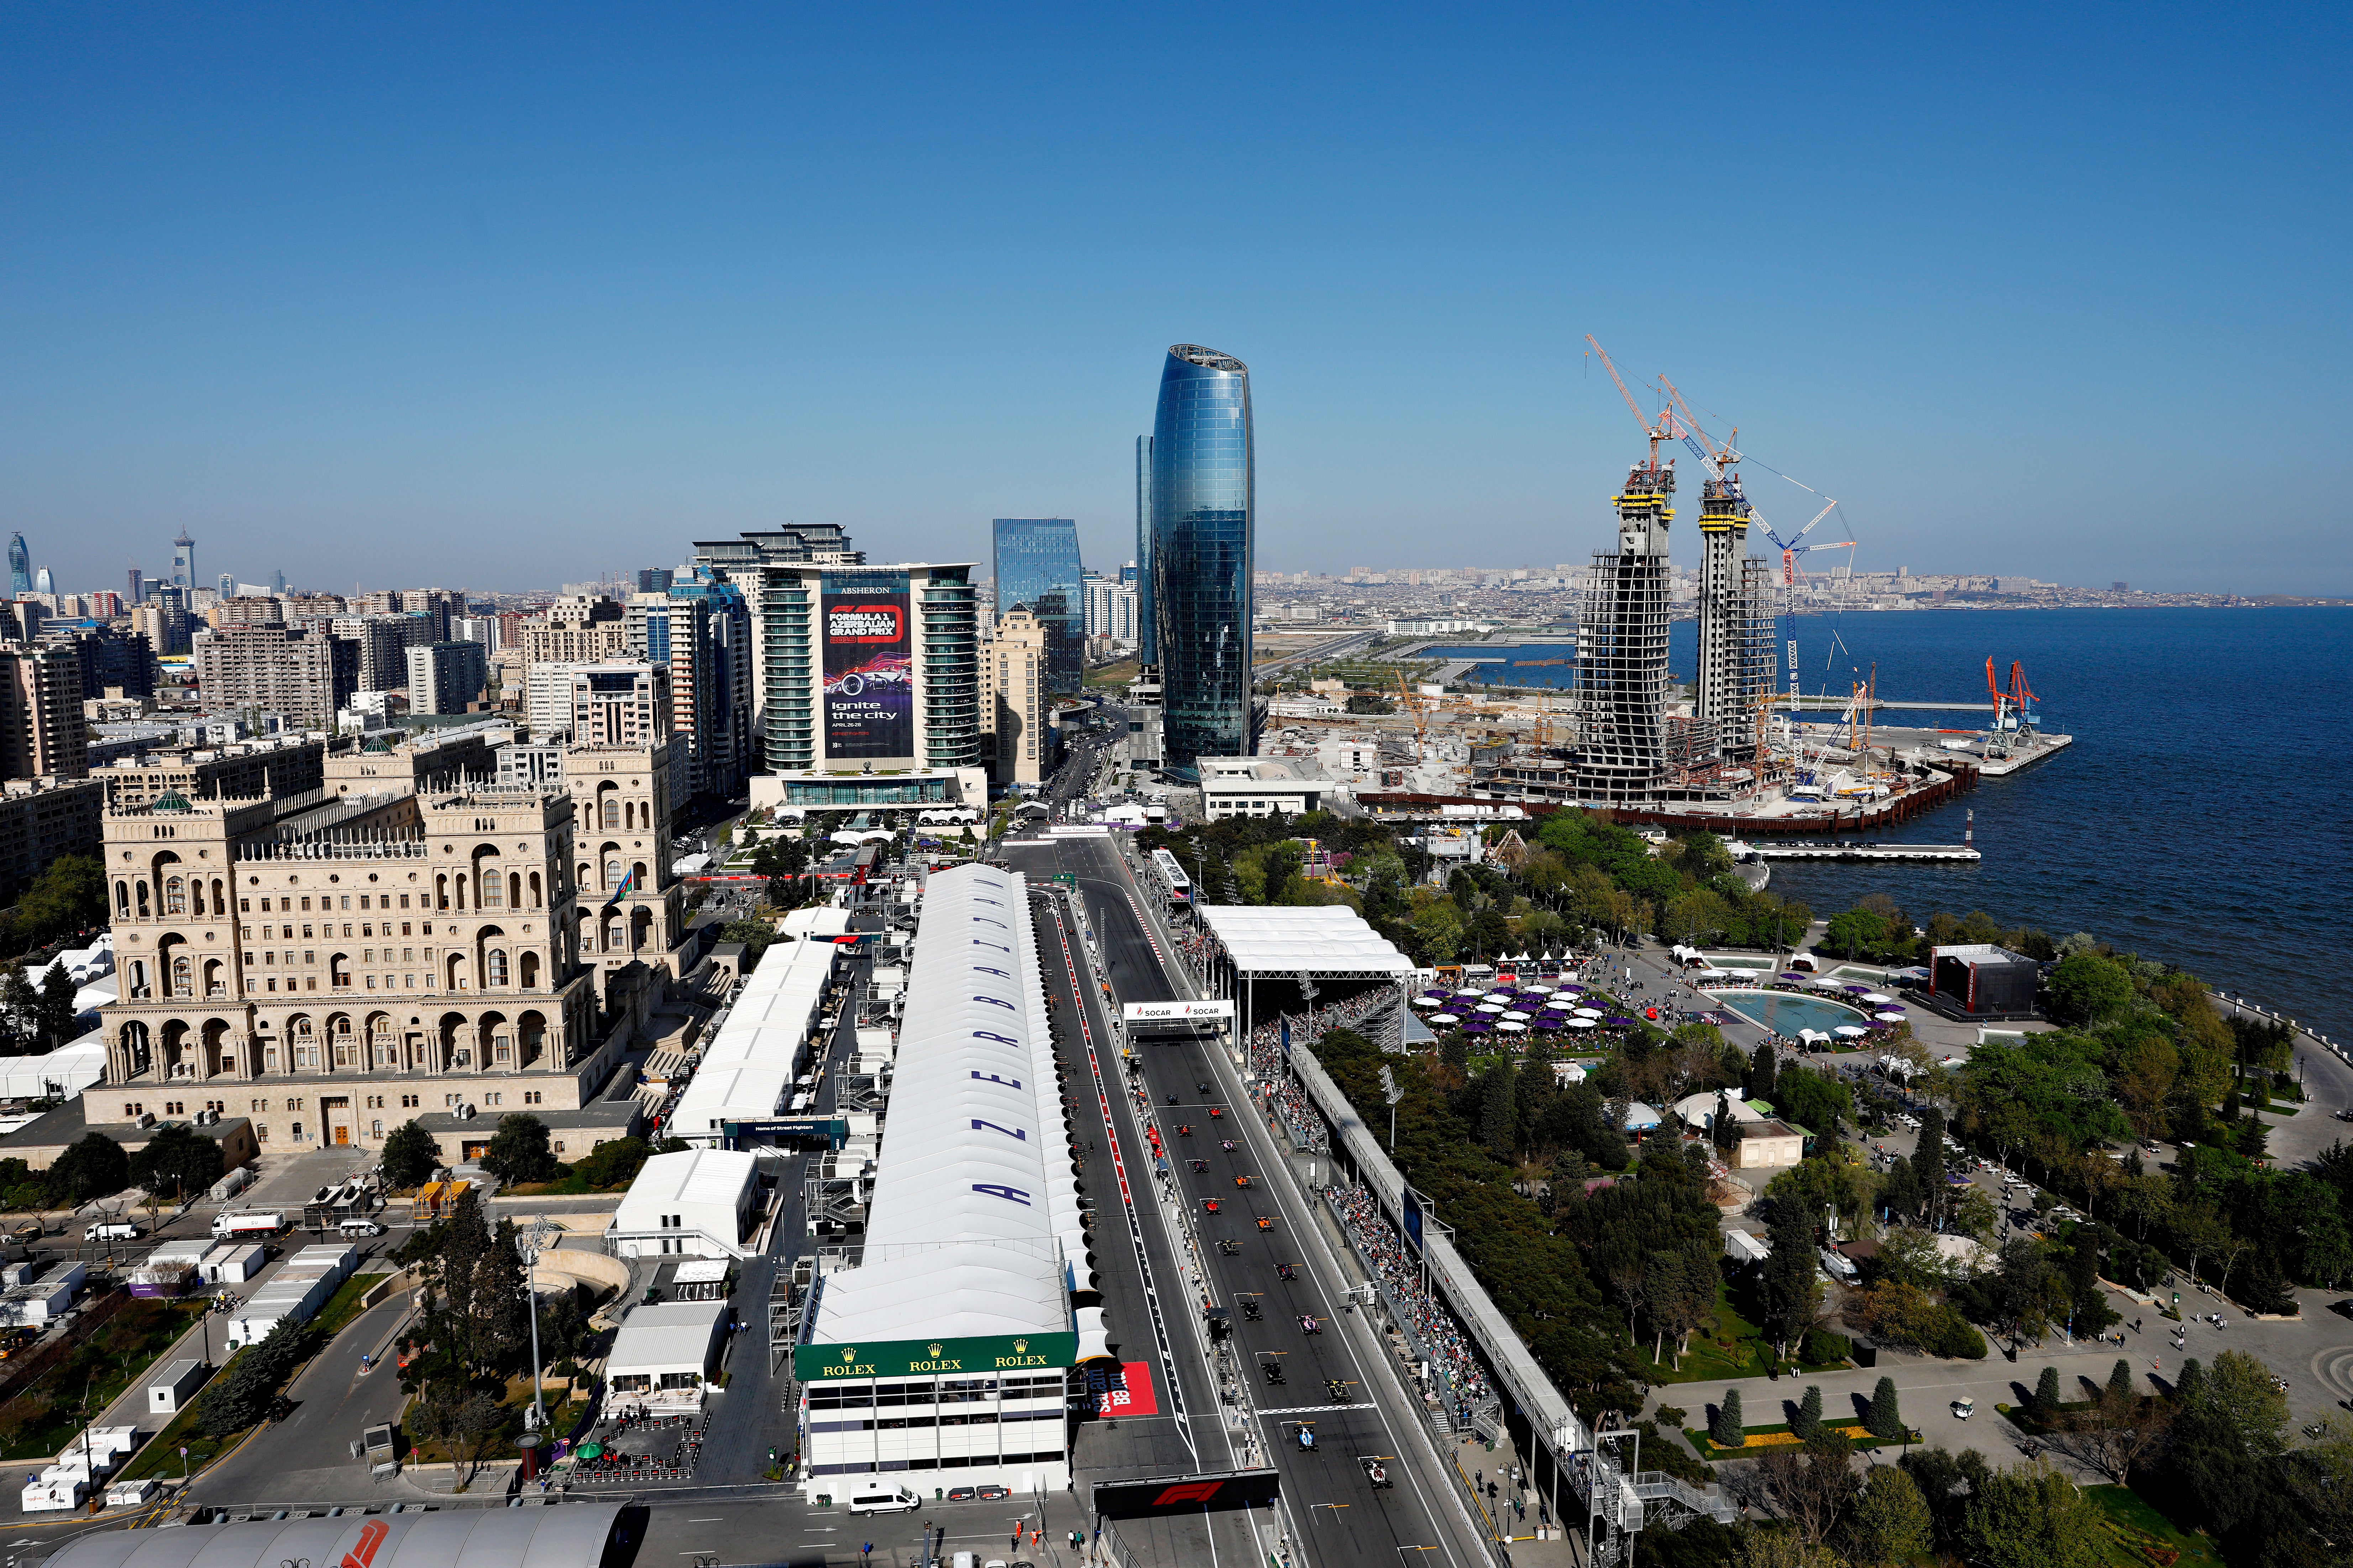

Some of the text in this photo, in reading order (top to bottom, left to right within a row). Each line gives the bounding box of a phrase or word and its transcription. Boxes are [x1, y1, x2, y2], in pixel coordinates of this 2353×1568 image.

[832, 702, 881, 711] Ignite
[864, 711, 897, 720] city
[971, 879, 1031, 1206] AZERBAIJAN
[823, 1355, 1047, 1376] ROLEX ROLEX ROLEX
